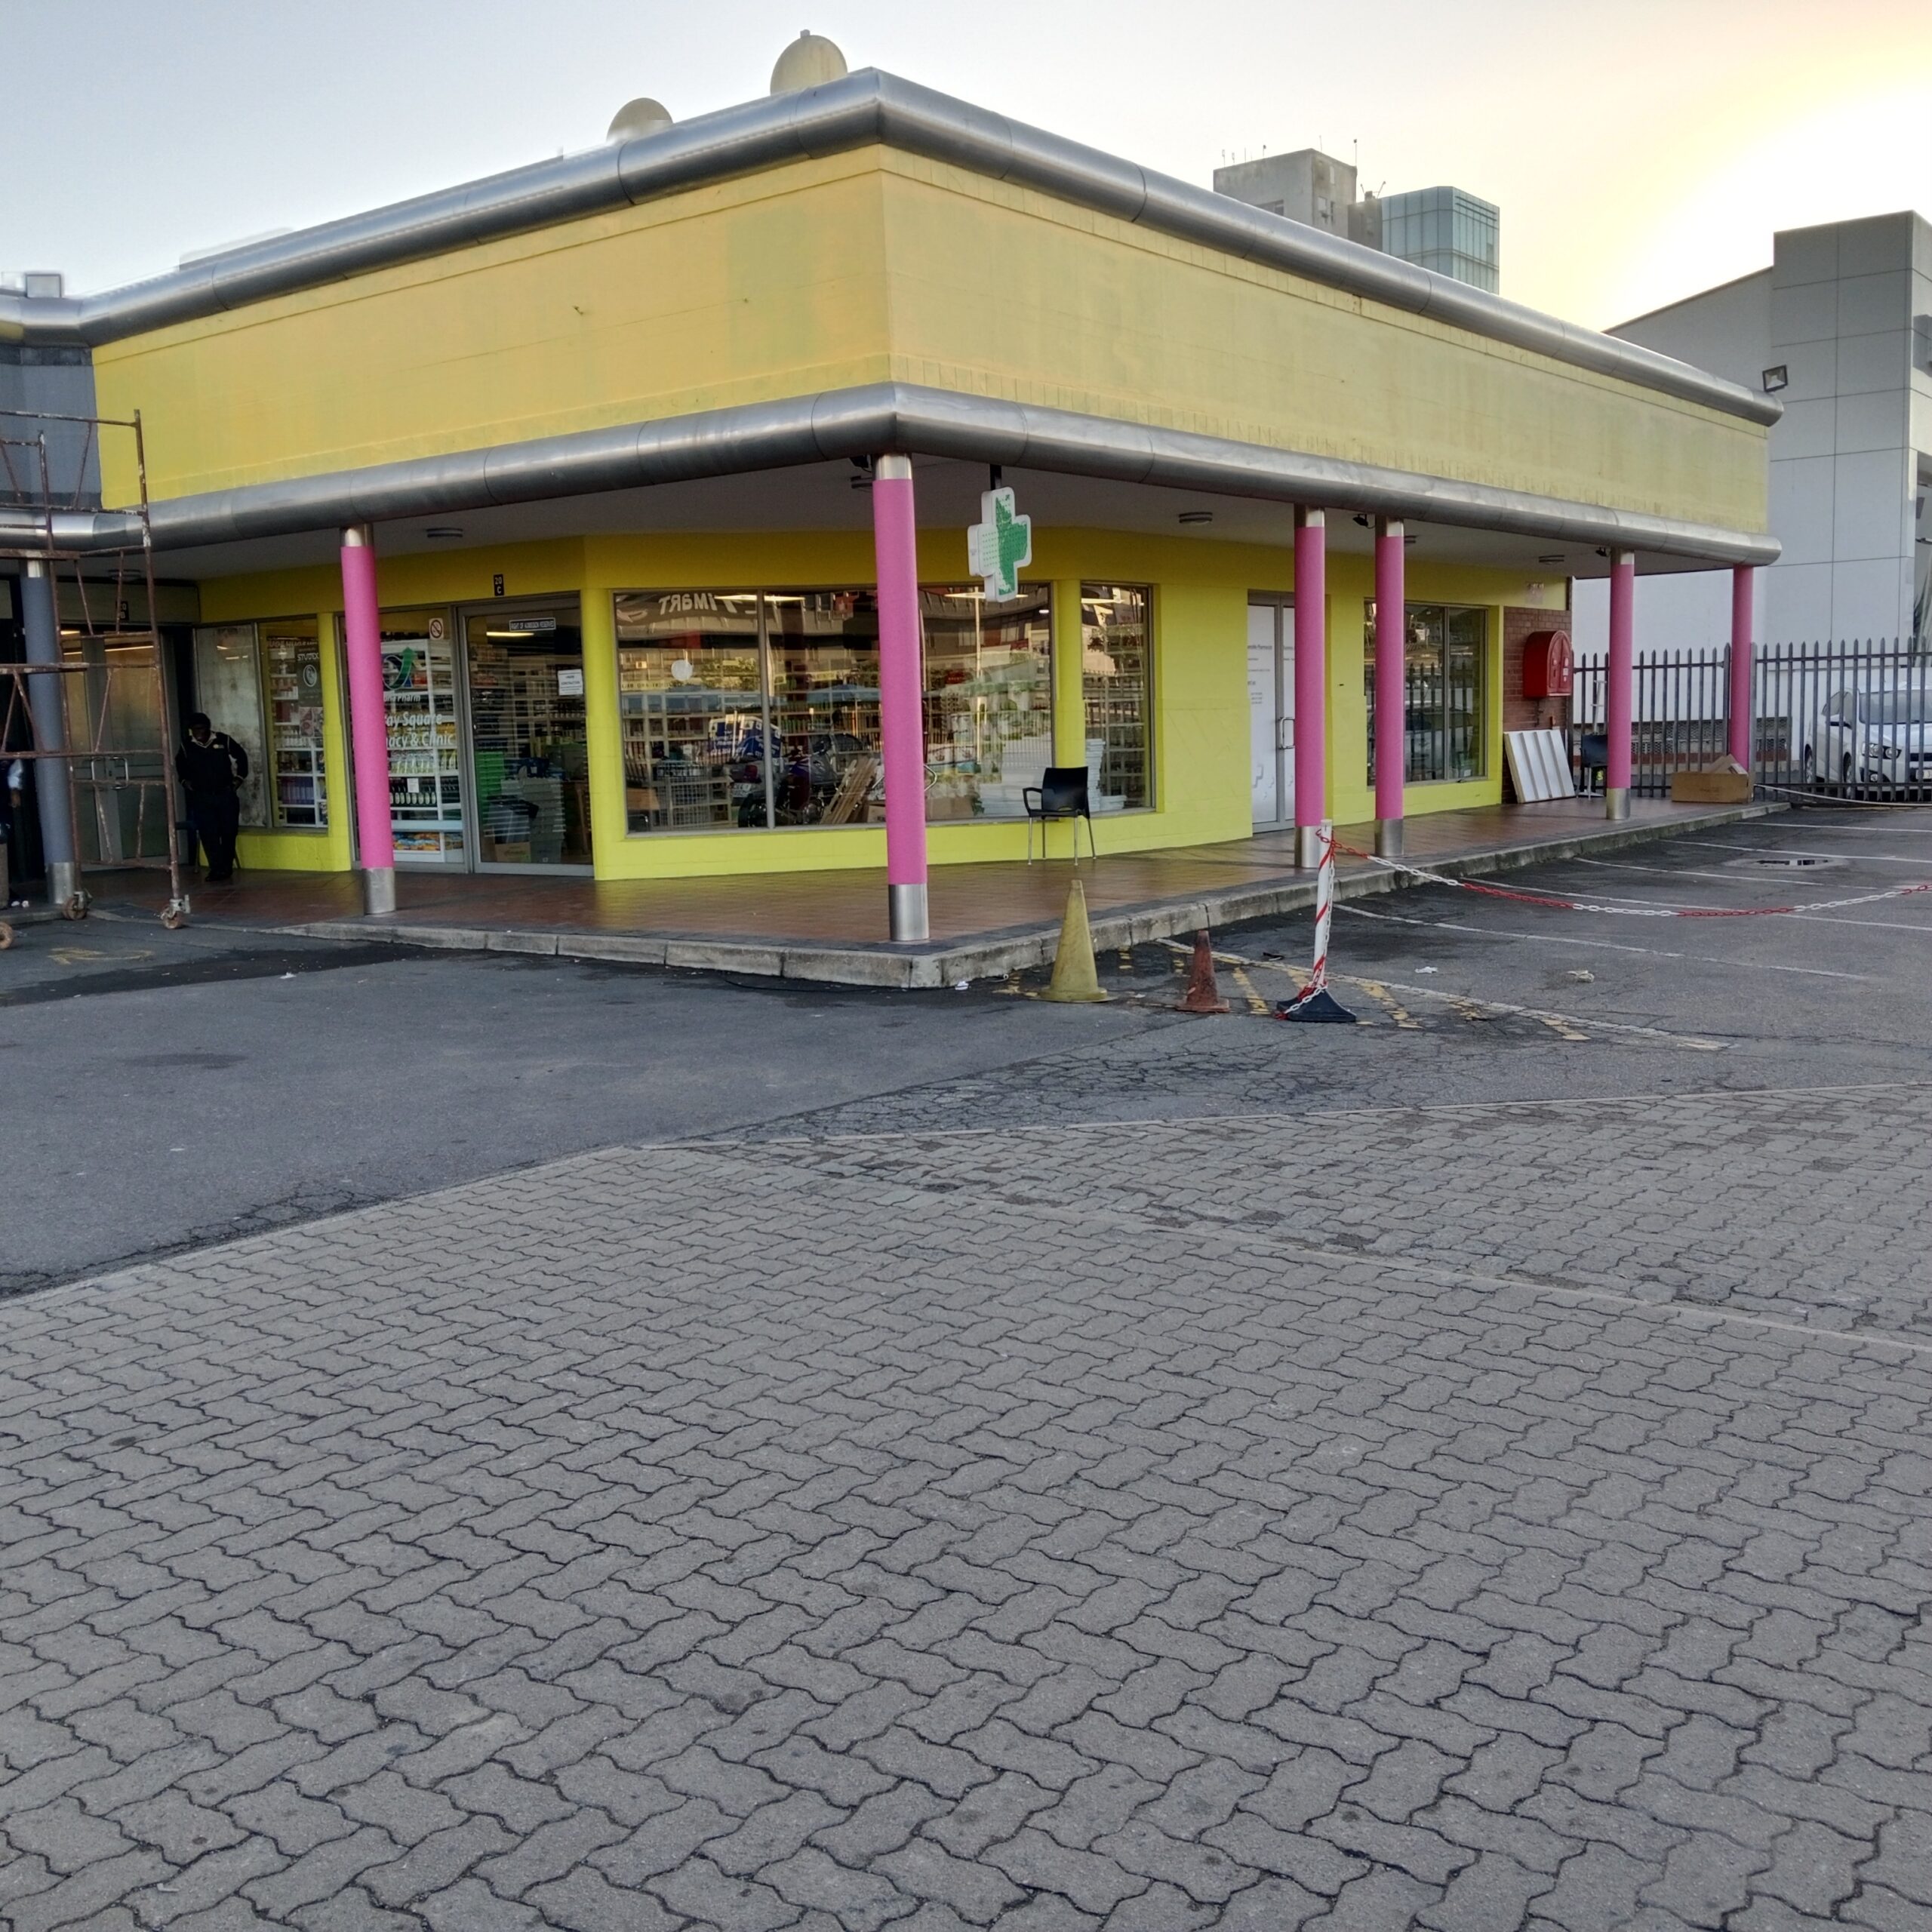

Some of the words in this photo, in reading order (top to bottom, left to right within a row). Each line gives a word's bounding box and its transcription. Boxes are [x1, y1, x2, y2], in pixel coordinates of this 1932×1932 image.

[497, 586, 502, 594] C
[397, 692, 421, 703] Pharm
[402, 711, 443, 731] Square
[410, 732, 420, 747] &
[422, 731, 456, 747] Clinic
